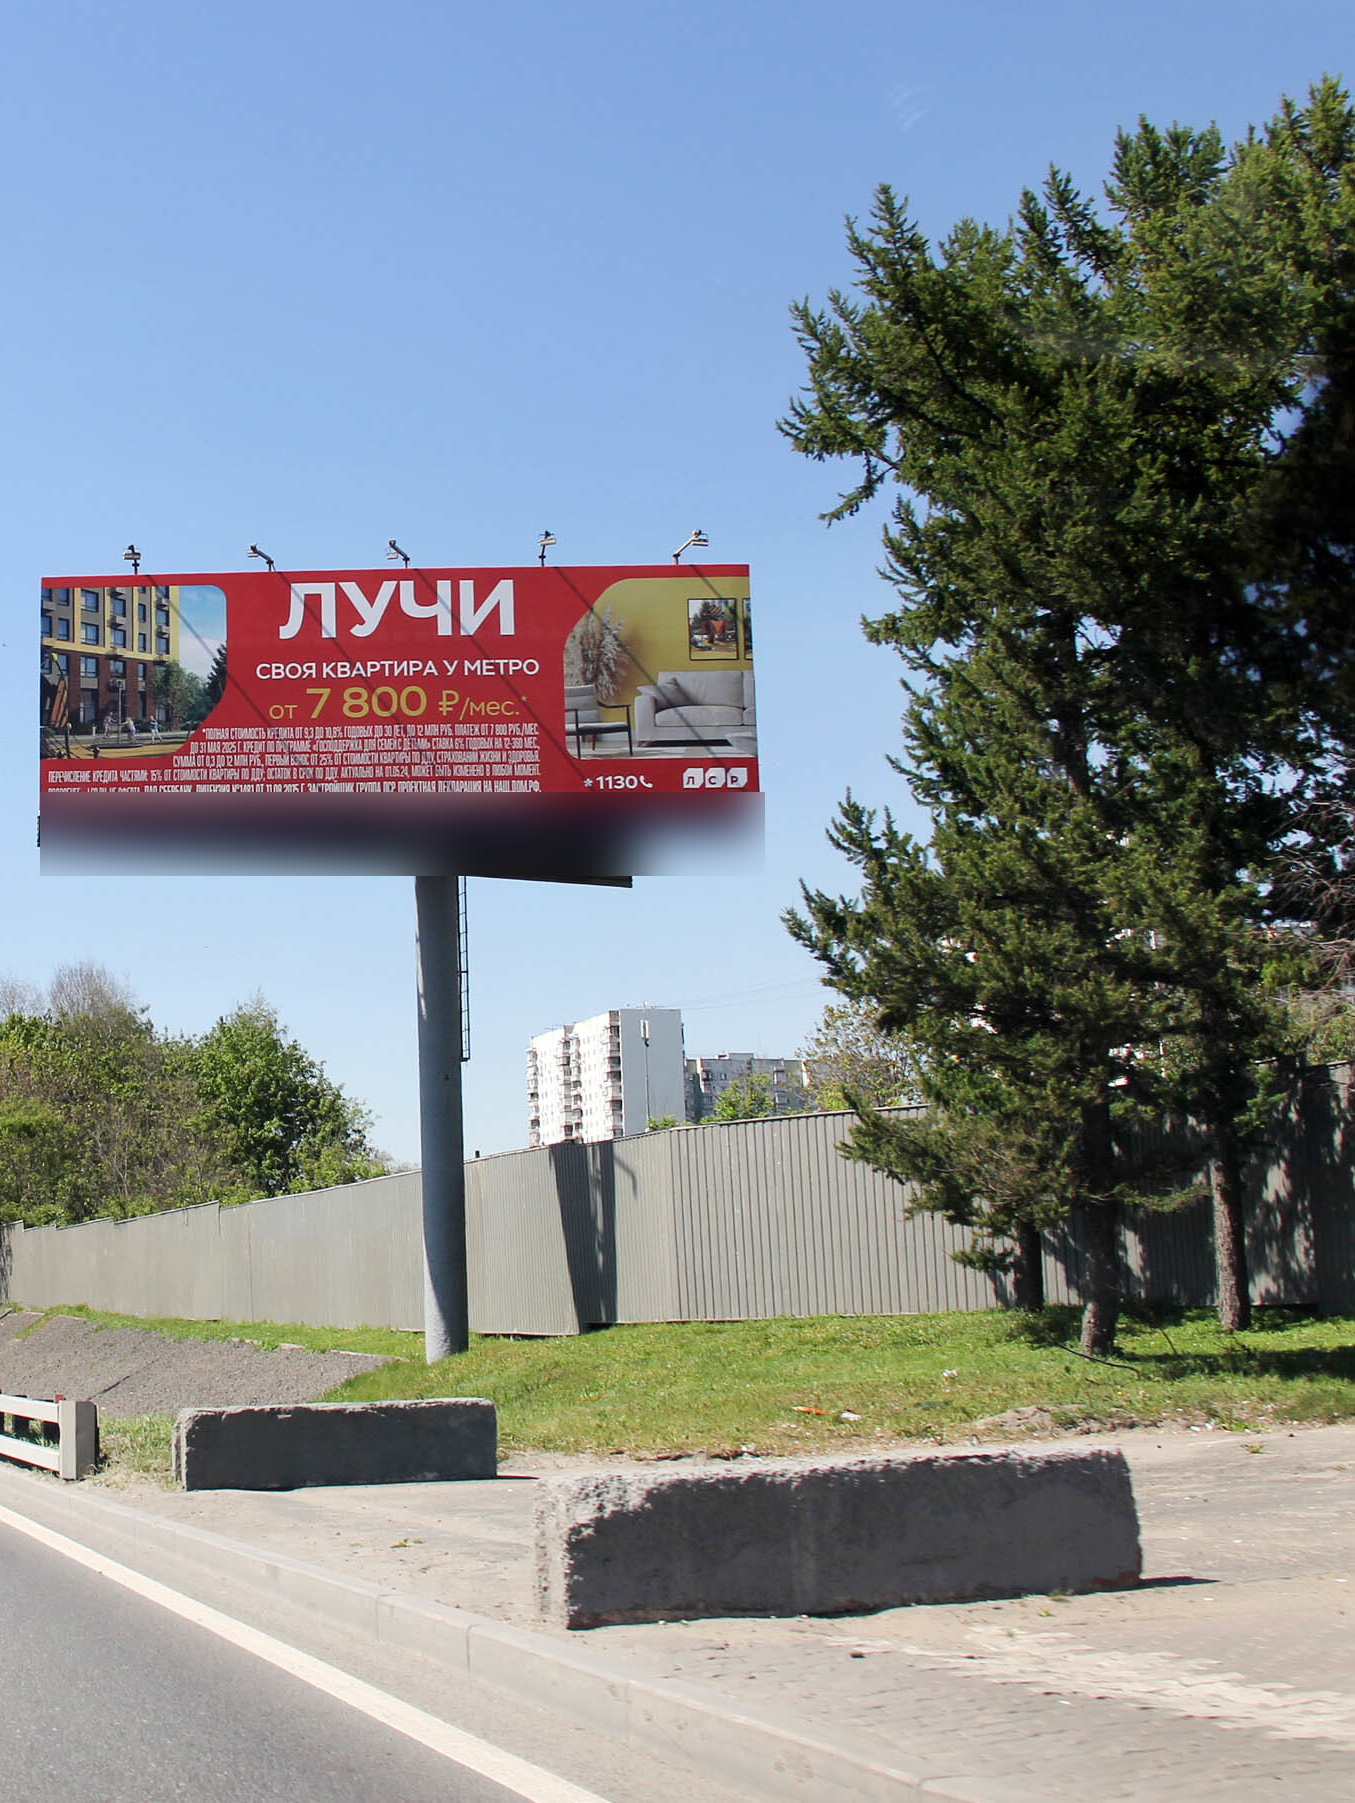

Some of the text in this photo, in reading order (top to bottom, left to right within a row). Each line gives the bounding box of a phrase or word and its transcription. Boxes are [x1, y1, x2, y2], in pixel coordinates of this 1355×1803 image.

[278, 579, 516, 640] ЛУЧИ
[255, 658, 541, 680] СВОЯ КВАРТИРА У МЕТРО
[269, 703, 299, 720] от
[306, 687, 332, 719] 7
[342, 685, 428, 718] 800
[230, 727, 266, 739] СТОИМОСТЬ
[267, 727, 294, 739] КРЕДИТА
[296, 727, 303, 738] ОТ
[315, 726, 324, 739] ДО
[344, 726, 373, 738] ГОДОВЫХ
[374, 725, 383, 738] ДО
[384, 725, 392, 736] 30
[407, 725, 415, 737] ДО
[417, 725, 423, 736] 12
[425, 725, 439, 736] МЛН
[455, 724, 479, 735] ПЛАТЕЖ
[481, 724, 488, 735] ОТ
[190, 741, 198, 754] ДО
[200, 741, 205, 753] 31
[206, 741, 220, 753] МАЯ
[222, 741, 236, 753] 2025
[244, 740, 265, 754] КРЕДИТ
[267, 740, 274, 752] ПО
[276, 740, 311, 752] ПРОГРАММЕ
[364, 739, 376, 752] ДЛЯ
[432, 738, 454, 749] СТАВКА
[466, 737, 493, 750] ГОДОВЫХ
[495, 737, 503, 749] НА
[173, 755, 196, 767] СУММА
[197, 755, 205, 766] ОТ
[216, 754, 225, 767] ДО
[227, 754, 232, 766] 12
[234, 754, 248, 766] МЛН
[290, 753, 309, 765] ВЗНОС
[311, 753, 318, 765] ОТ
[334, 753, 342, 764] ОТ
[344, 752, 378, 764] СТОИМОСТИ
[379, 752, 410, 764] КВАРТИРЫ
[412, 752, 420, 763] ПО
[479, 751, 500, 763] ЖИЗНИ
[48, 770, 91, 782] ПЕРЕЧИСЛЕНИЕ
[93, 770, 118, 783] КРЕДИТА
[164, 769, 171, 780] ОТ
[173, 769, 208, 780] СТОИМОСТИ
[210, 768, 240, 780] КВАРТИРЫ
[242, 768, 249, 779] ПО
[267, 767, 291, 779] ОСТАТОК
[316, 767, 324, 778] ПО
[341, 766, 373, 778] АКТУАЛЬНО
[375, 766, 383, 777] НА
[412, 765, 434, 777] МОЖЕТ
